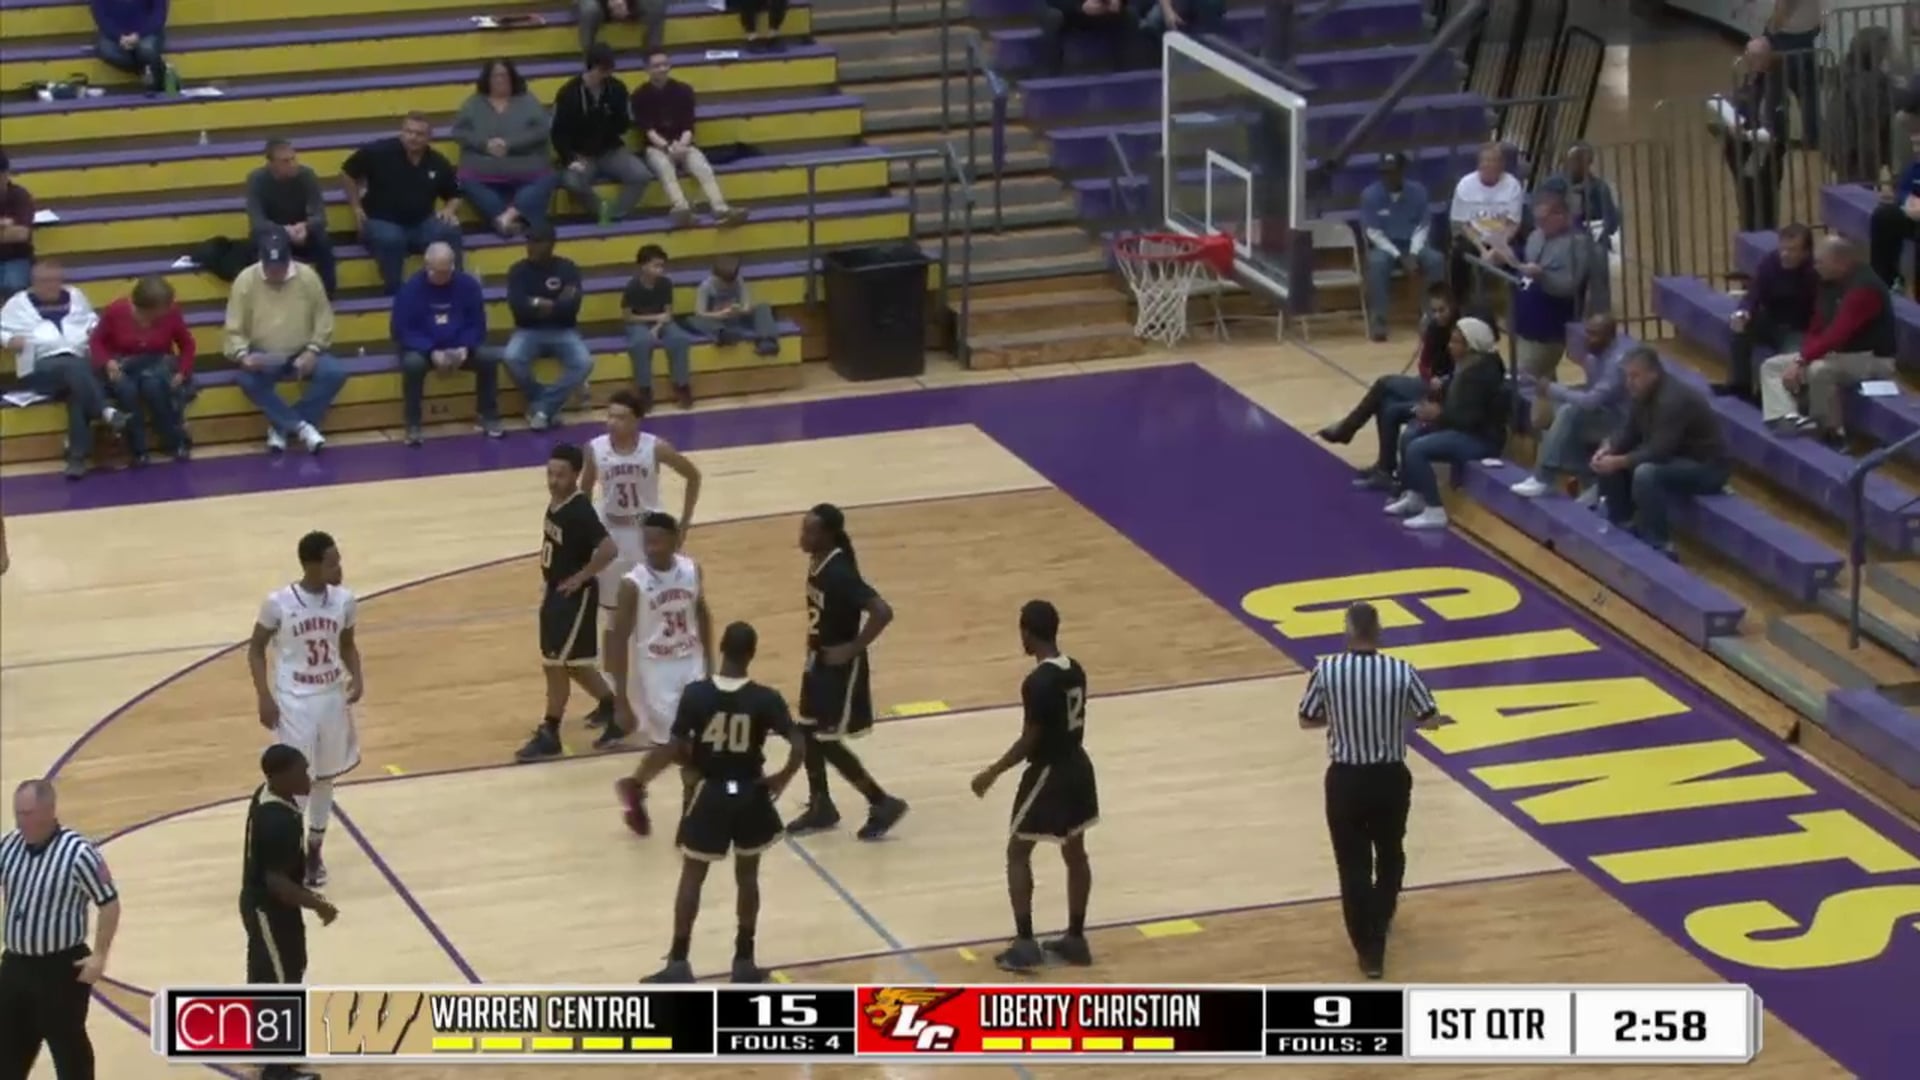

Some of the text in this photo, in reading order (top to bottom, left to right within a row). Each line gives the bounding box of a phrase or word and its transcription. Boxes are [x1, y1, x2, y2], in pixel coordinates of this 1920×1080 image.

[615, 483, 639, 508] 31
[292, 616, 338, 637] LIBERTY
[662, 610, 687, 637] 34
[305, 639, 333, 666] 32
[702, 713, 751, 752] 40
[1242, 566, 1920, 969] GIANTS
